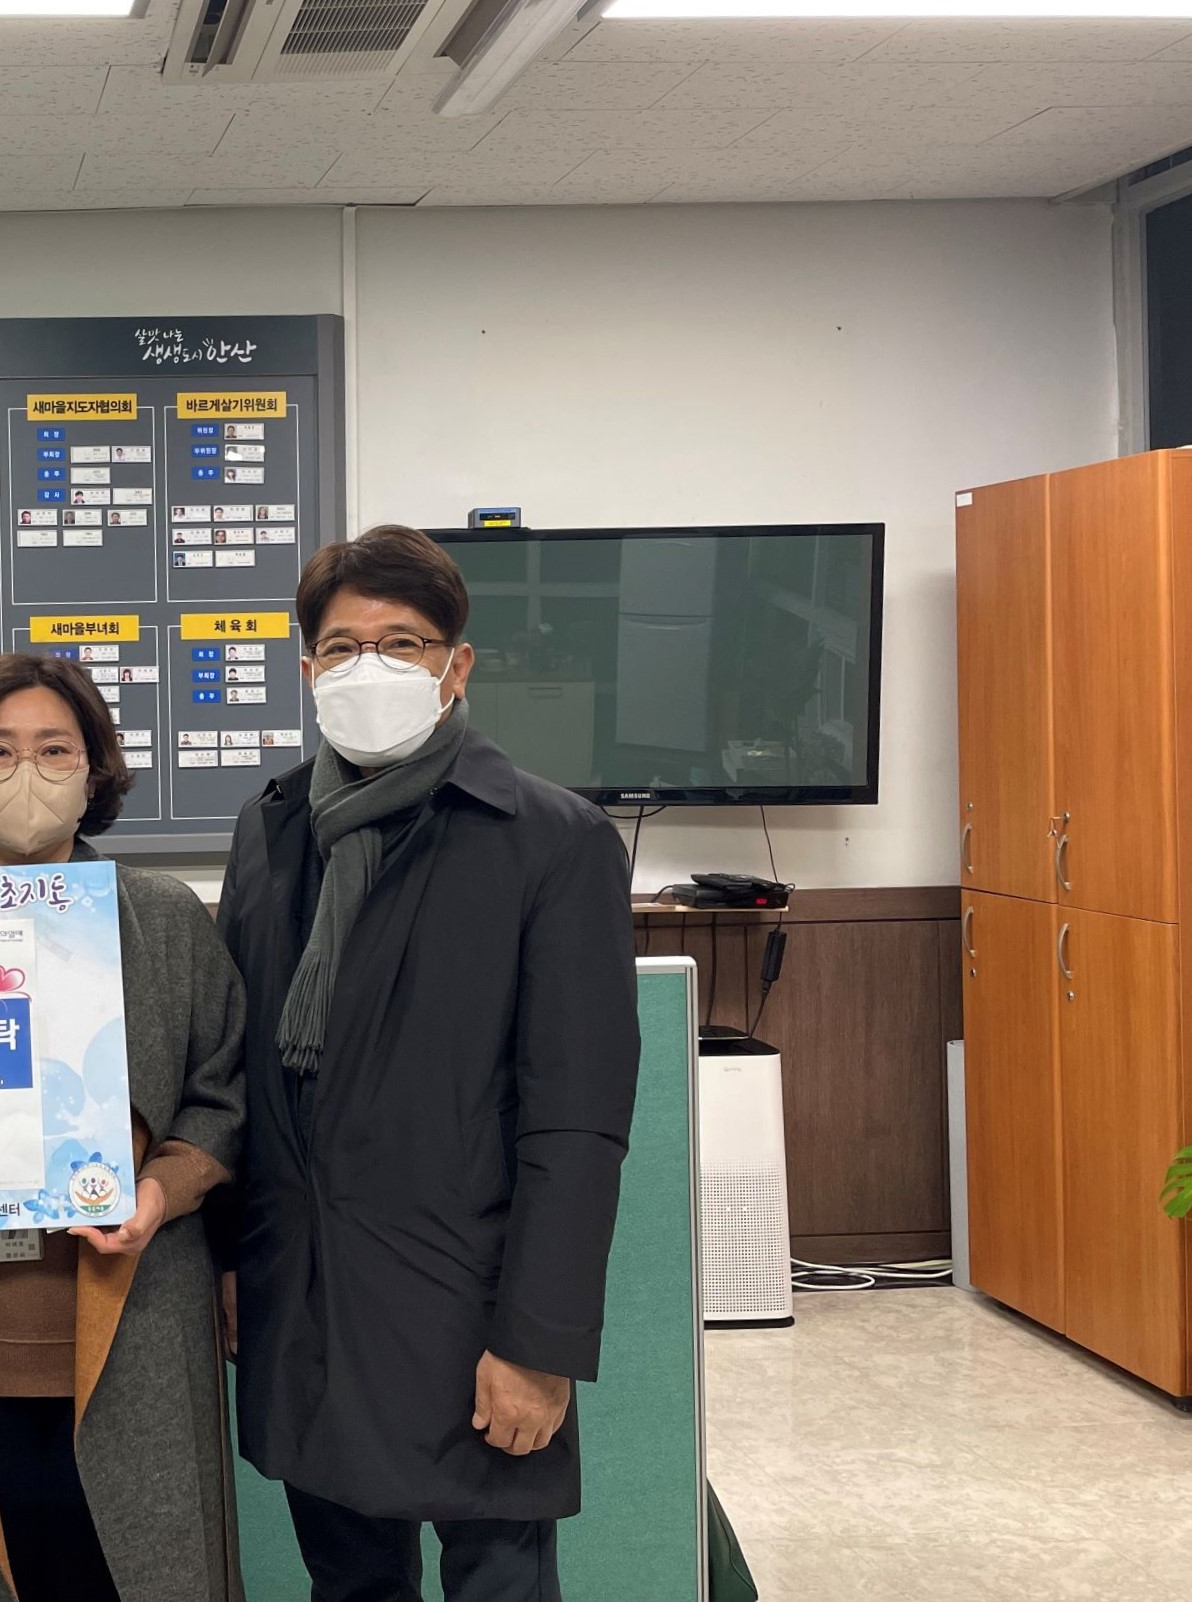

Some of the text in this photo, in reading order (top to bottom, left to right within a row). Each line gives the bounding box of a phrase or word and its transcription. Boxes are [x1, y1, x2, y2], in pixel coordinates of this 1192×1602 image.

[142, 339, 257, 365] 생생도시 안산
[32, 400, 133, 414] 새마을지도자협의회
[185, 398, 278, 412] 바르게살기위원회
[194, 447, 217, 455] 부위원장
[50, 621, 120, 636] 새마을부녀회
[0, 875, 73, 911] 초지동
